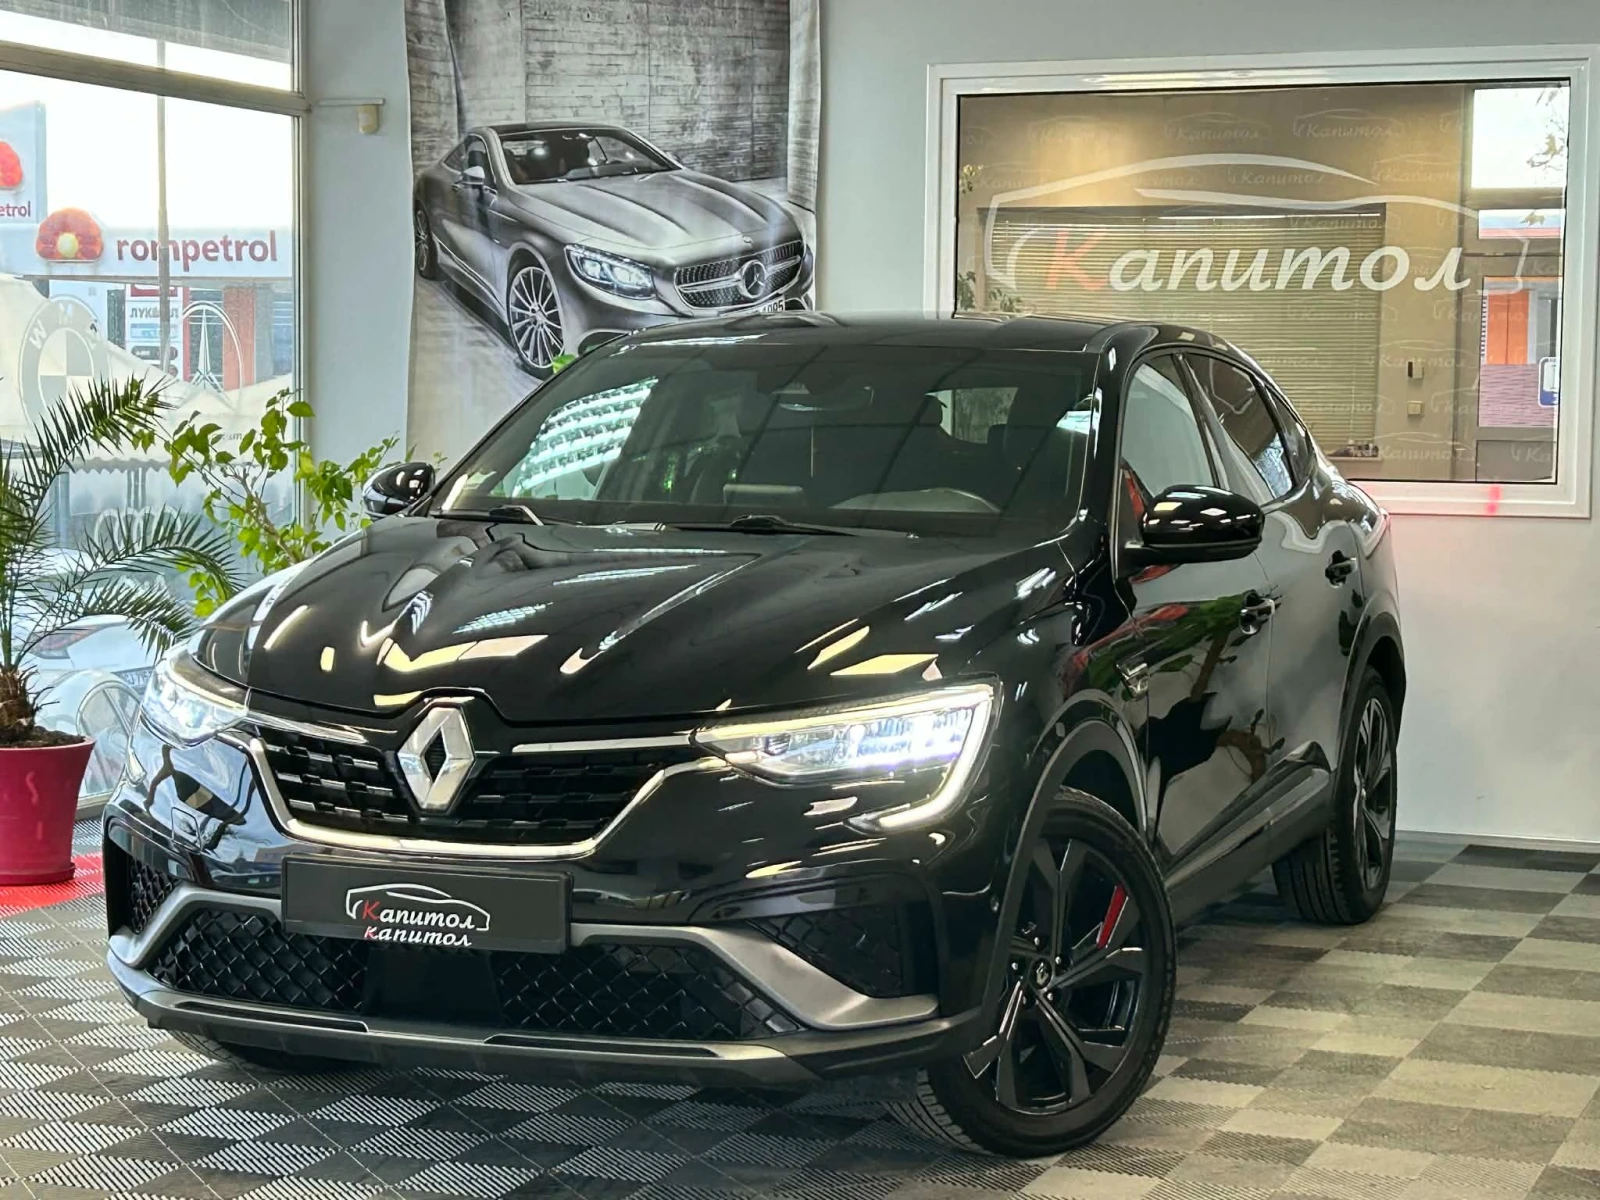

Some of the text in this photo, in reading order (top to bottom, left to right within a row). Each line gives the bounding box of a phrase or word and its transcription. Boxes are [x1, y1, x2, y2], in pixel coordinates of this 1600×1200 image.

[116, 230, 278, 273] rompetrol
[1045, 230, 1471, 291] Капитол
[362, 899, 476, 929] Капитол
[364, 926, 472, 947] Капитол
